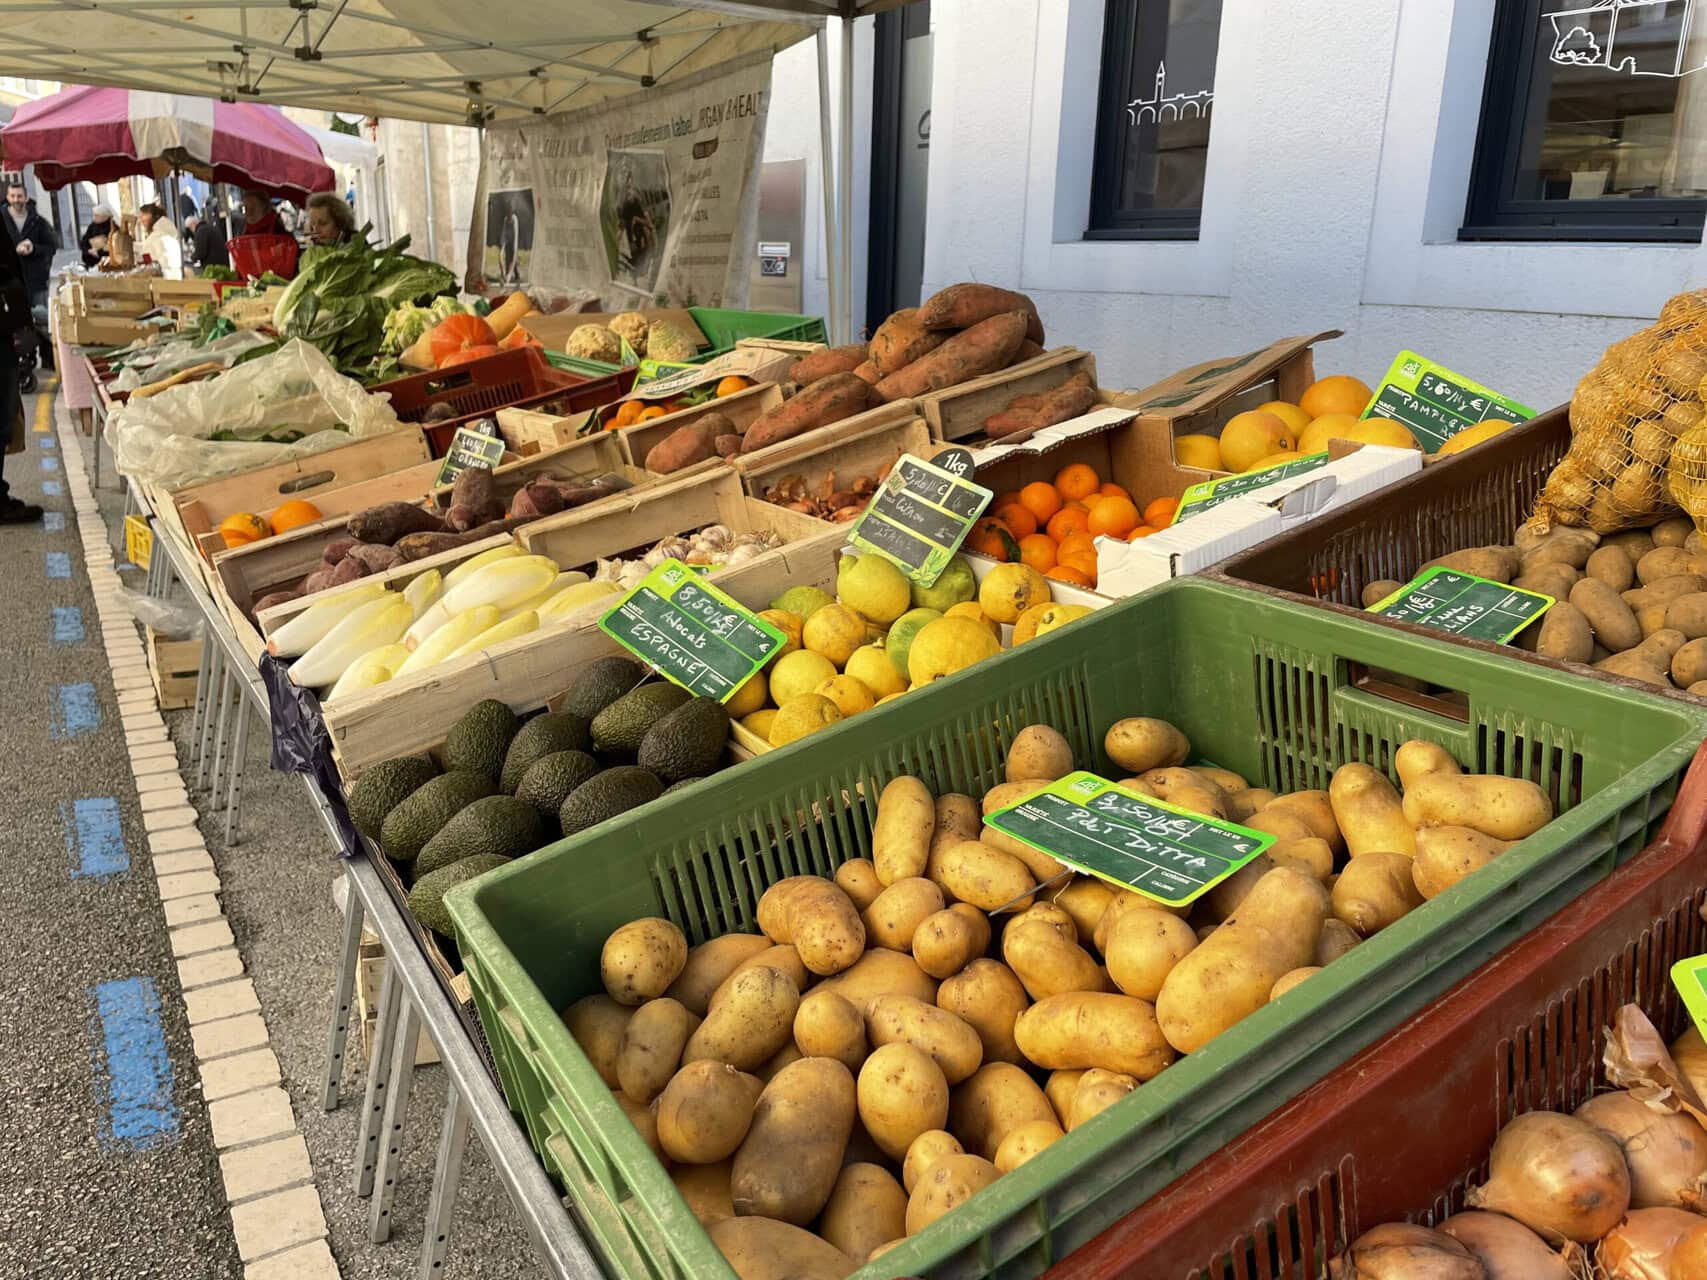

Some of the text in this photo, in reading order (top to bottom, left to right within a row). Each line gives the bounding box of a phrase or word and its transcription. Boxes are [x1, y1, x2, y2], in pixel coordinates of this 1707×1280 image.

[944, 452, 968, 475] 1kg
[630, 622, 704, 675] ESPAGNE
[660, 610, 707, 649] Avocats
